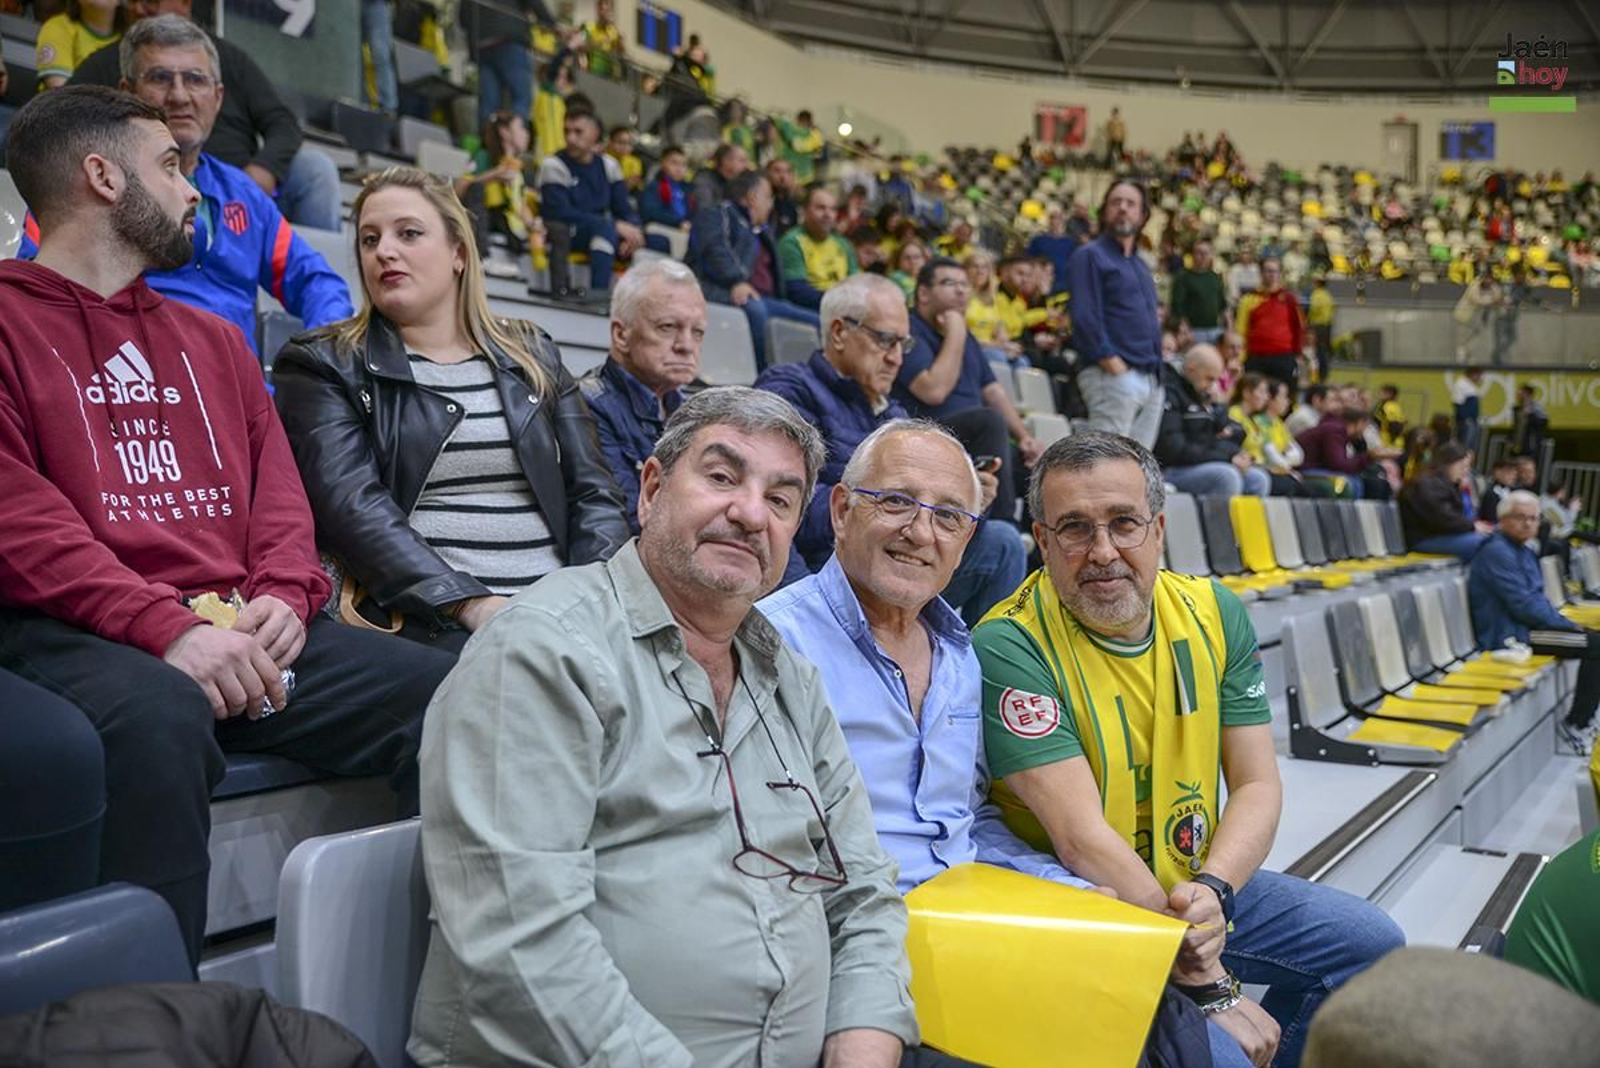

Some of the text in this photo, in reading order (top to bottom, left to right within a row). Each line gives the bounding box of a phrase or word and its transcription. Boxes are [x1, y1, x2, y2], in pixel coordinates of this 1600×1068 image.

[114, 439, 181, 484] 1949
[101, 486, 231, 508] FOR THE BEST
[108, 503, 233, 522] ATHLETES
